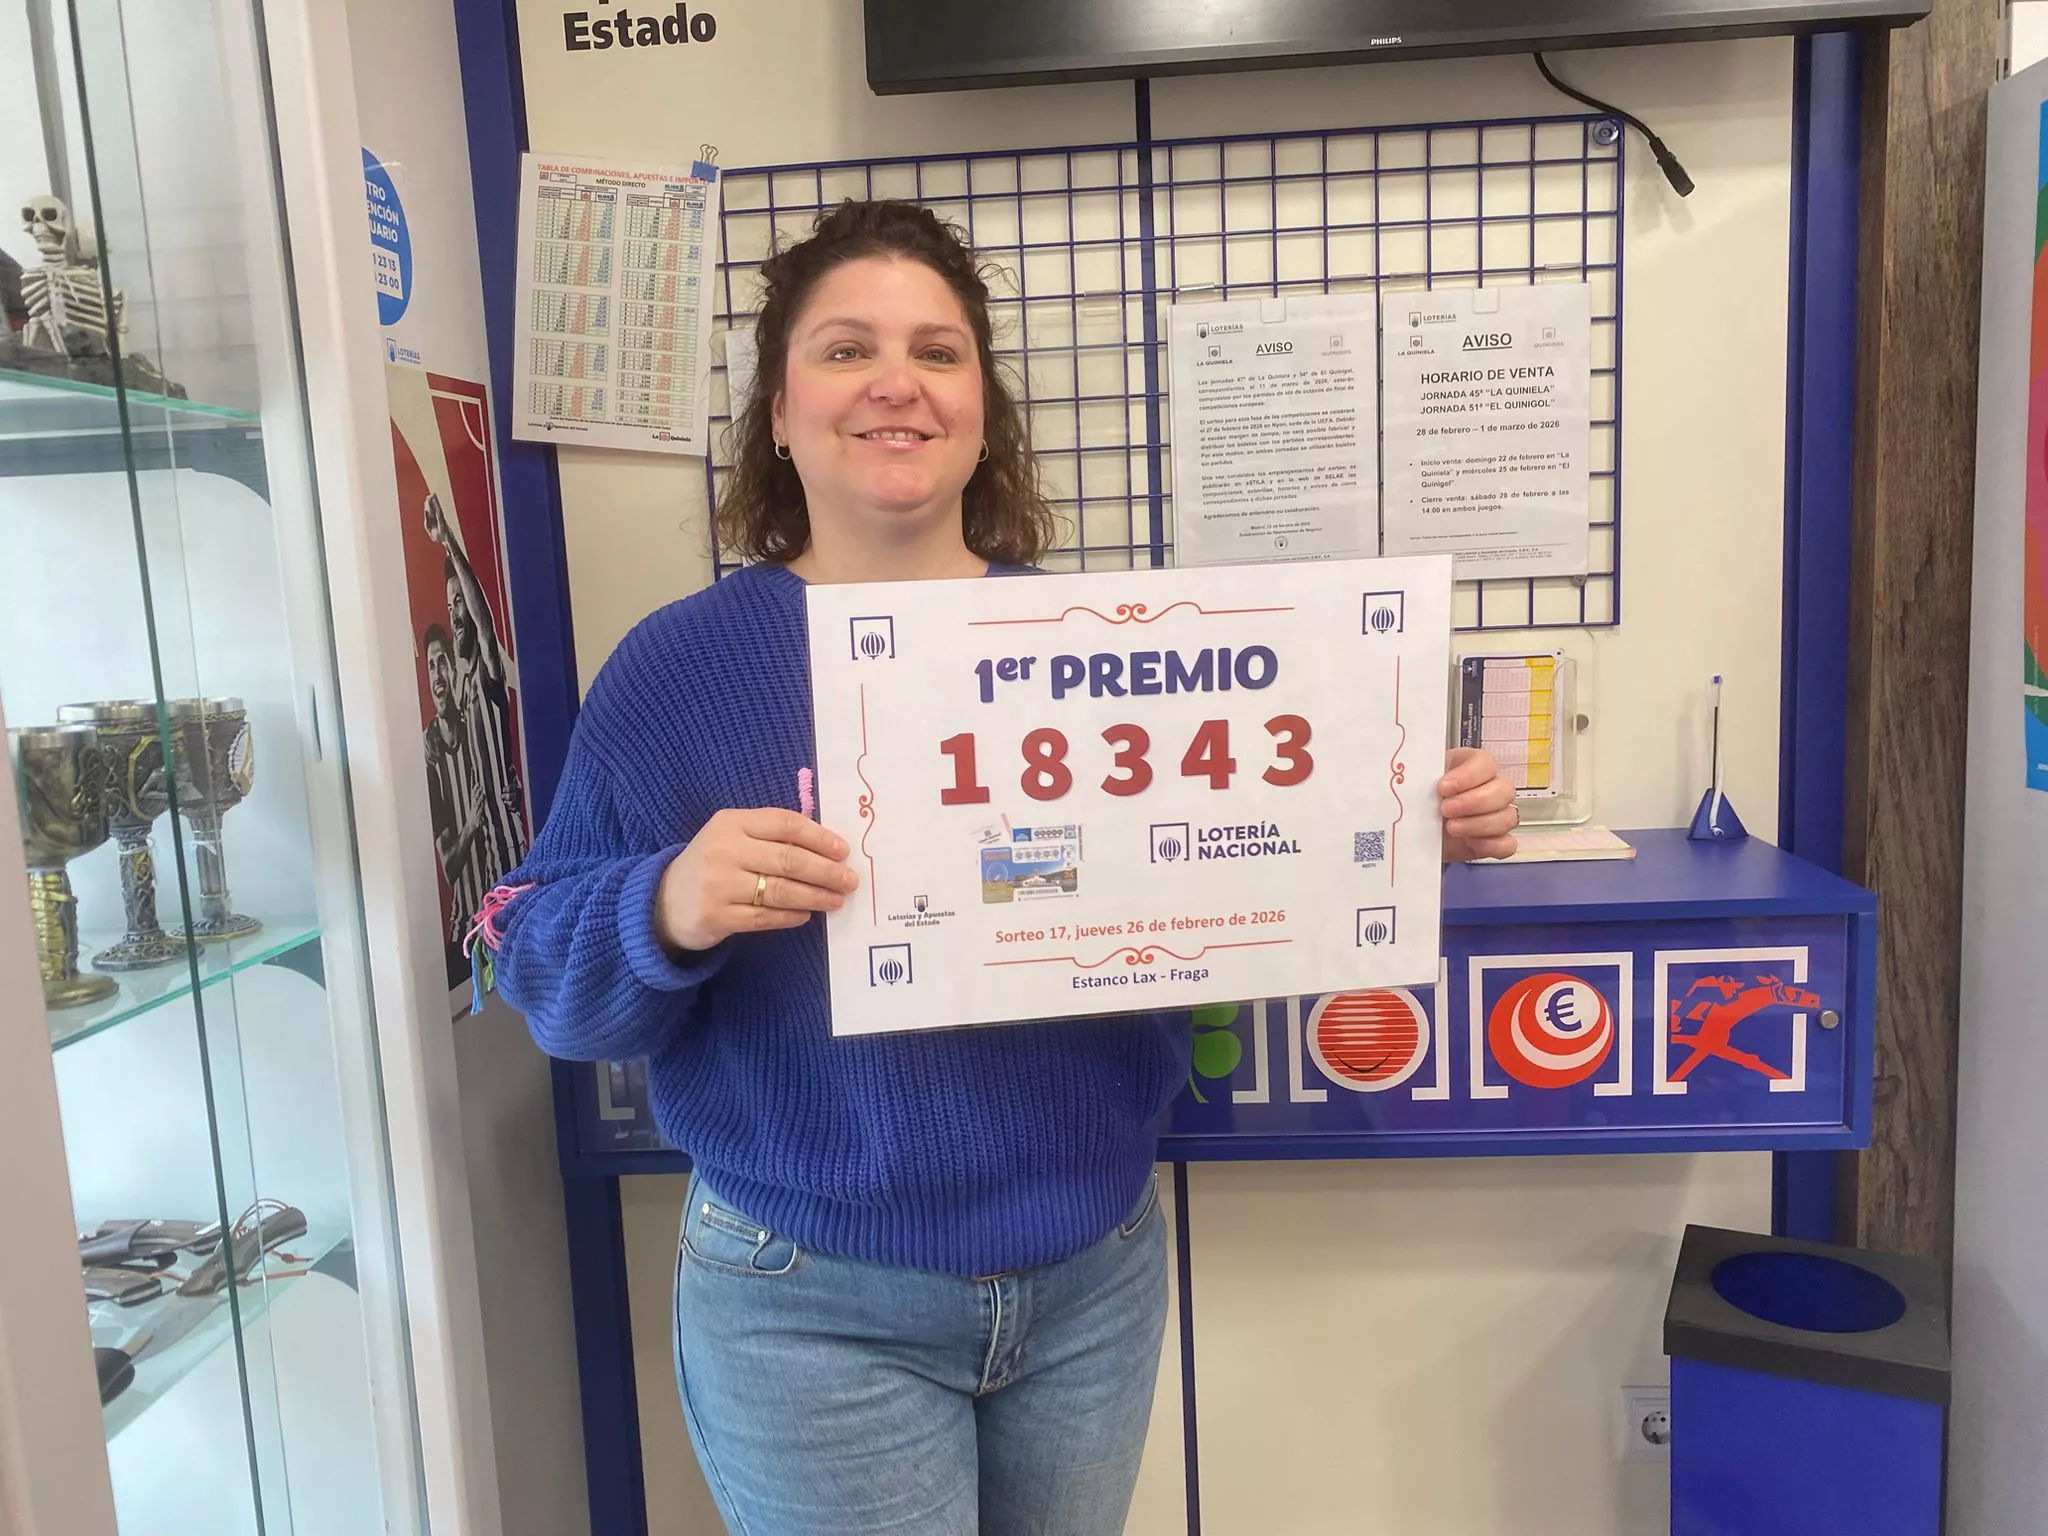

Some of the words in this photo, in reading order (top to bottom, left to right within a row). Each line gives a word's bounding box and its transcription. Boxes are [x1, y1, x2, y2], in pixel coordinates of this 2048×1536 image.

[563, 2, 717, 51] Estado
[1370, 36, 1402, 46] PHILIPS
[537, 164, 559, 172] TABLA
[571, 167, 631, 179] COMBINACIONES,
[633, 173, 668, 182] APUESTAS
[596, 178, 621, 187] MÉTODO
[622, 180, 645, 188] DIRECTO
[378, 255, 387, 269] 23
[389, 259, 396, 272] 13
[378, 272, 388, 286] 23
[389, 276, 399, 290] 00
[1423, 313, 1456, 321] LOTERÍAS
[1211, 324, 1243, 332] LOTERÍAS
[1462, 333, 1511, 349] AVISO
[398, 347, 420, 360] LOTERÍAS
[1256, 342, 1293, 354] AVISO
[1421, 370, 1483, 384] HORARIO
[1487, 368, 1505, 380] DE
[1509, 366, 1554, 378] VENTA
[1420, 390, 1466, 400] JORNADA
[1420, 405, 1466, 415] JORNADA
[1417, 428, 1426, 436] 28
[1428, 427, 1438, 435] de
[1440, 426, 1470, 434] febrero
[1480, 424, 1484, 432] 1
[1487, 424, 1497, 432] de
[1527, 421, 1537, 429] de
[1540, 420, 1559, 429] 2026
[1420, 458, 1440, 466] Inicio
[1508, 453, 1517, 461] de
[1462, 466, 1496, 474] miércoles
[1421, 495, 1442, 503] Cierre
[1452, 504, 1476, 512] ambos
[1477, 504, 1503, 512] juegos.
[974, 655, 1037, 703] 1er
[1050, 645, 1279, 699] PREMIO
[940, 714, 1315, 806] 18343
[1198, 821, 1281, 843] LOTERÍA
[1198, 840, 1302, 860] NACIONAL
[888, 913, 917, 922] Loterías
[924, 910, 956, 920] Apuestas
[904, 920, 916, 928] del
[917, 918, 941, 927] Estado
[995, 927, 1045, 943] Sorteo
[1049, 926, 1072, 941] 17,
[1074, 923, 1123, 940] jueves
[1126, 919, 1145, 935] 26
[1148, 916, 1168, 932] de
[1170, 914, 1225, 930] febrero
[1228, 911, 1248, 926] de
[1250, 909, 1287, 925] 2026
[1071, 973, 1129, 989] Estanco
[1133, 971, 1157, 985] Lax
[1170, 967, 1210, 983] Fraga
